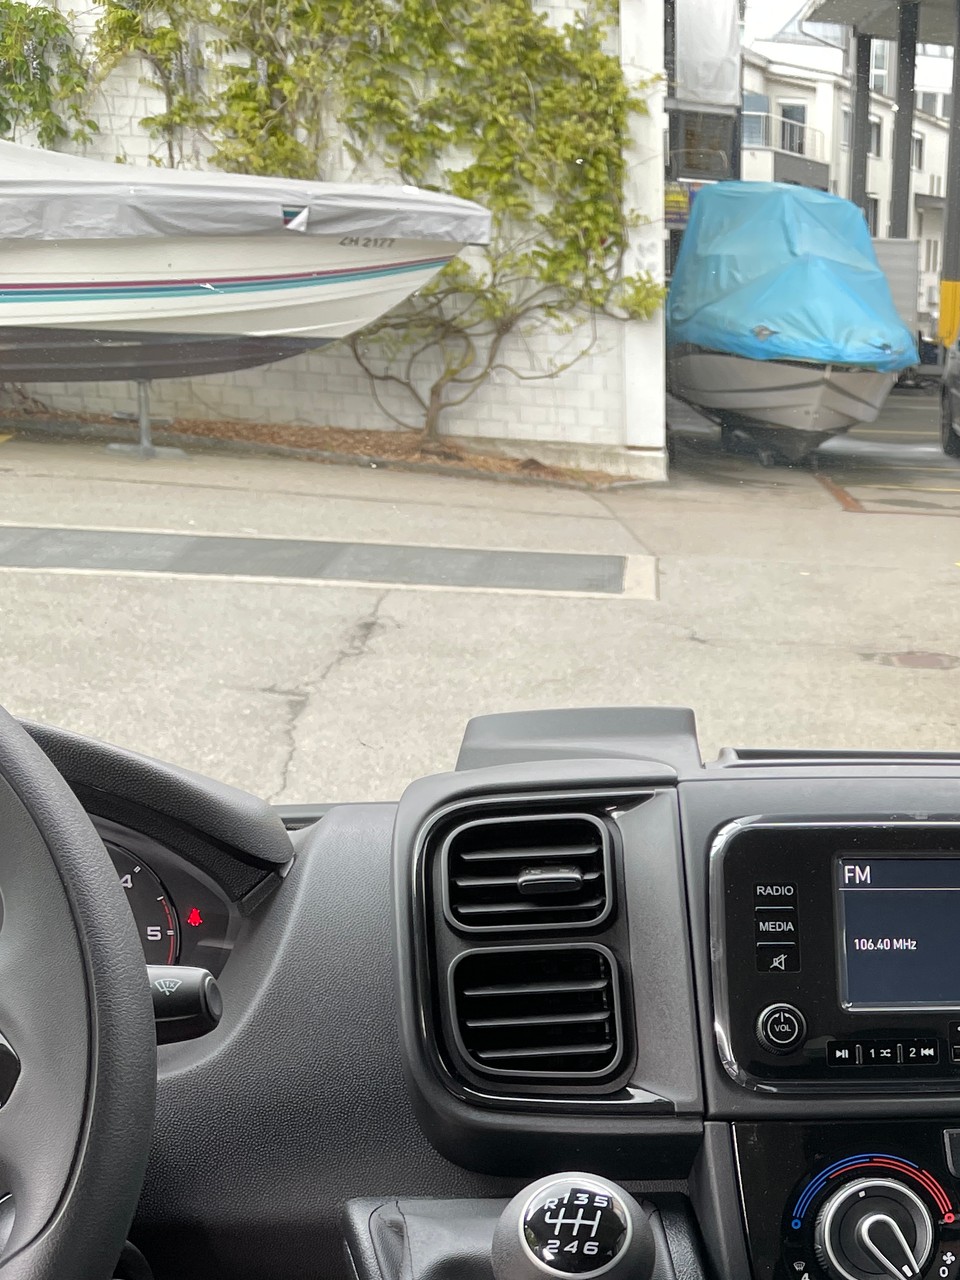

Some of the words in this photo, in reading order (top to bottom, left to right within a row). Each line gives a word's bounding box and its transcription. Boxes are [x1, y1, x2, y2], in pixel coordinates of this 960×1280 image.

[844, 865, 871, 884] FM
[120, 874, 133, 889] 4
[756, 885, 794, 896] RADIO
[759, 921, 795, 932] MEDIA
[147, 926, 162, 940] 5
[854, 938, 891, 950] 106.40
[893, 938, 917, 950] MHz
[774, 1024, 792, 1033] VOL
[869, 1048, 875, 1058] 1
[909, 1047, 916, 1058] 2
[939, 1266, 949, 1278] 0
